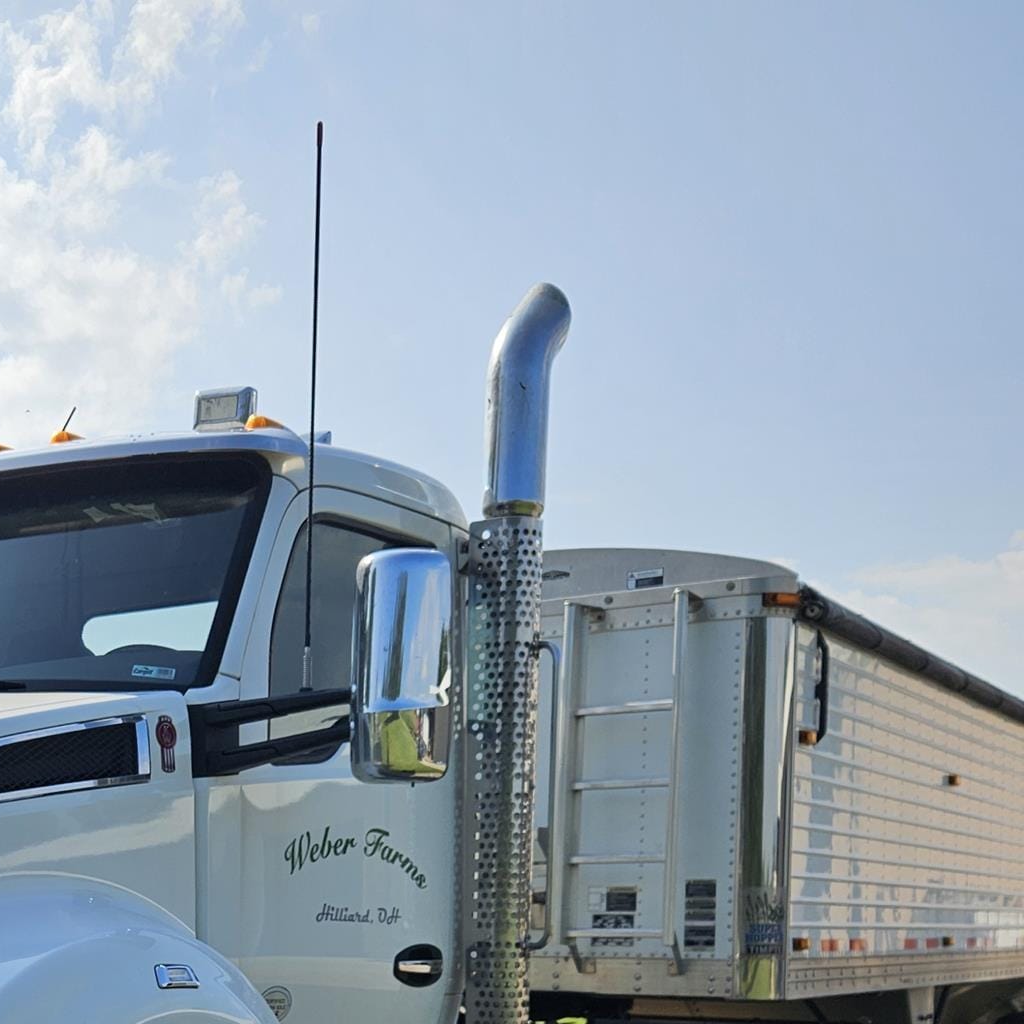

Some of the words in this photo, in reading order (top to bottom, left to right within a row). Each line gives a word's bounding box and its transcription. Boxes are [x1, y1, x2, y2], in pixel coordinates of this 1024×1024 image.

[284, 826, 357, 875] Weber
[363, 828, 427, 889] Farms
[315, 903, 374, 924] Hilliard,
[377, 907, 402, 925] OH
